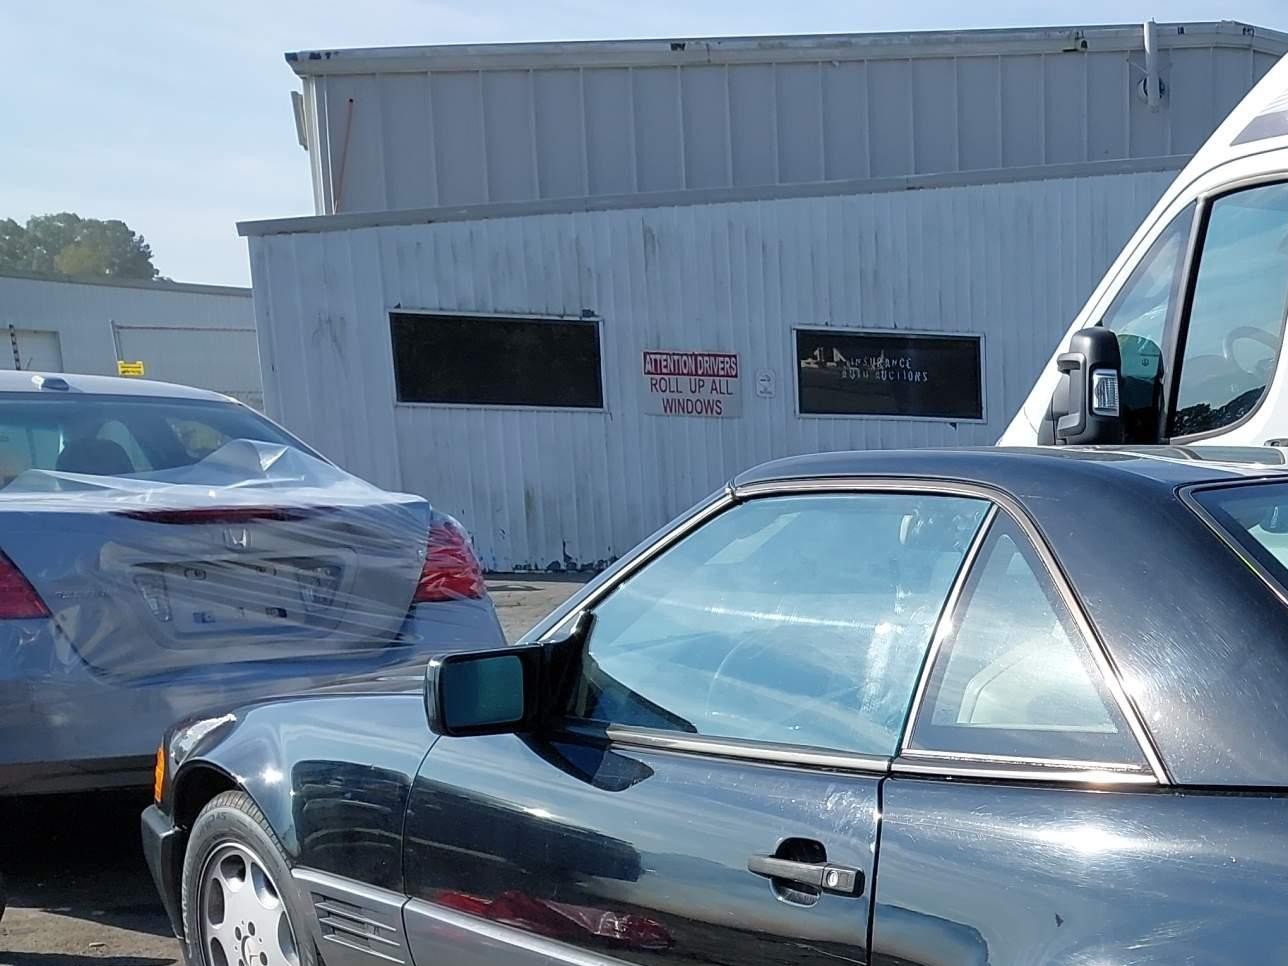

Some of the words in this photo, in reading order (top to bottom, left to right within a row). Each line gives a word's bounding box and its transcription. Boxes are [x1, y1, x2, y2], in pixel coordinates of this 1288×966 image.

[645, 353, 696, 374] ATTENTION
[697, 356, 737, 376] DRIVERS
[650, 377, 683, 394] ROLL
[689, 378, 705, 394] UP
[710, 379, 734, 395] ALL
[662, 398, 723, 416] WINDOWS
